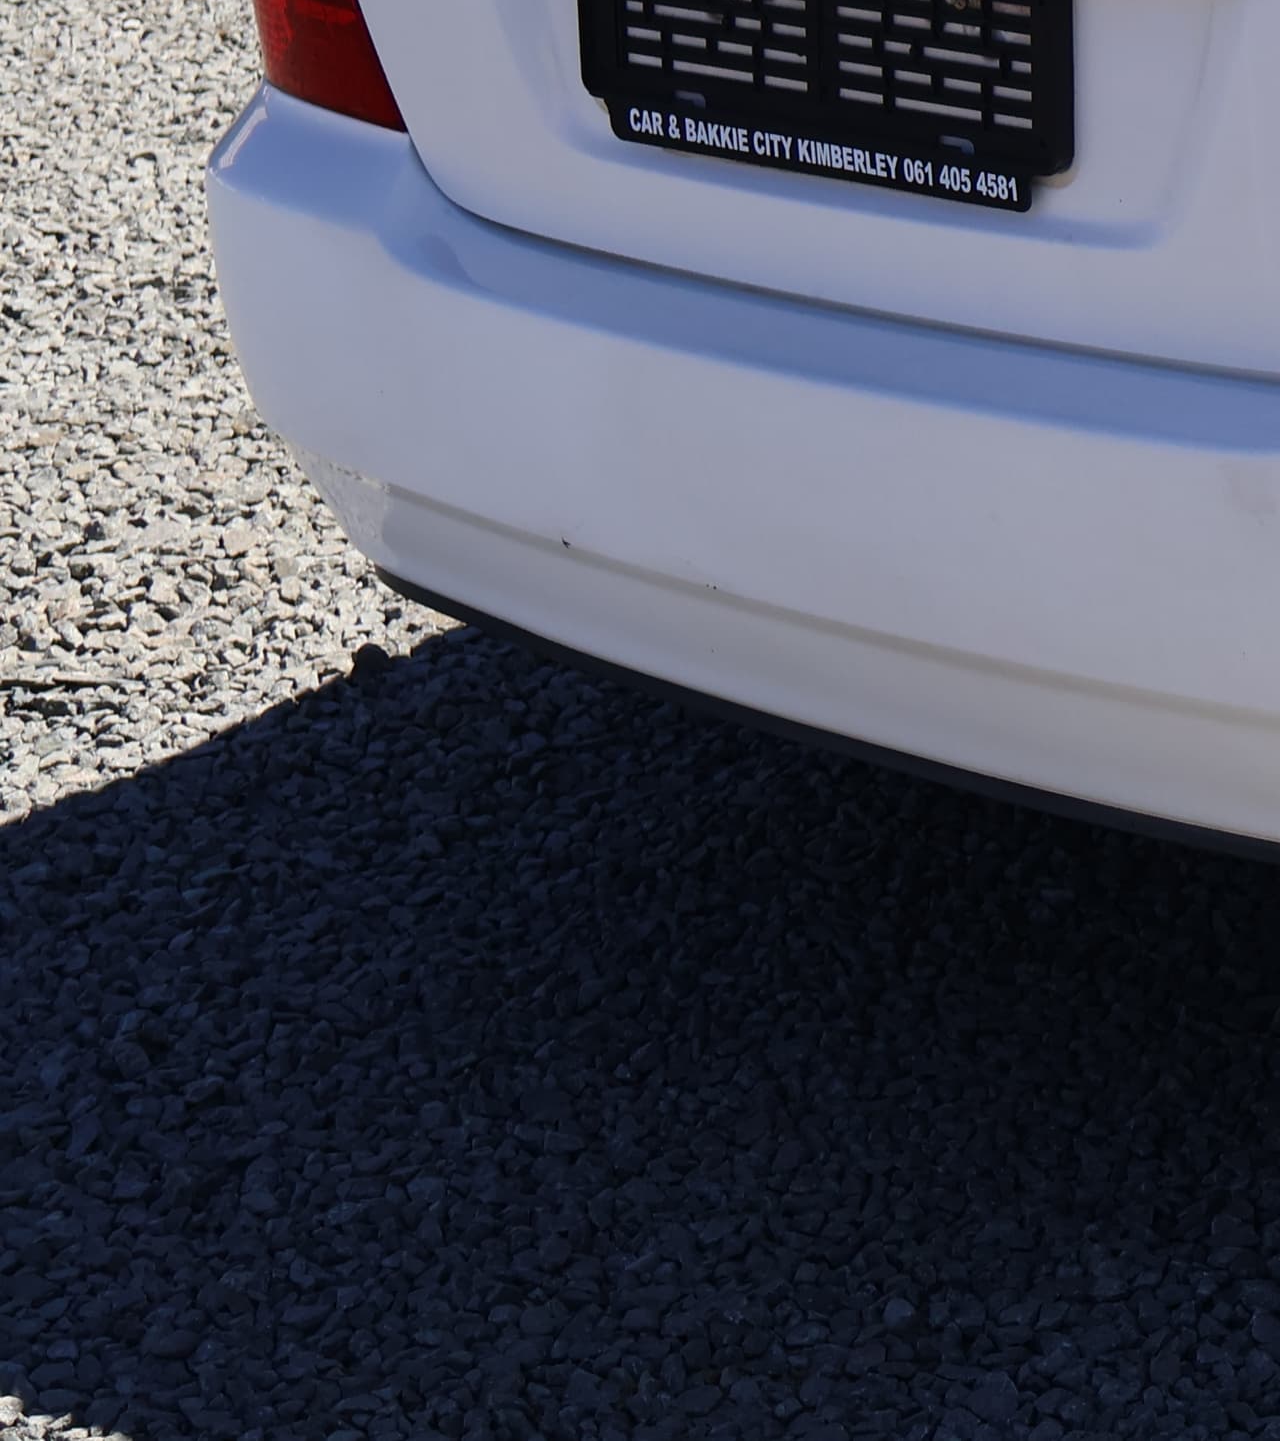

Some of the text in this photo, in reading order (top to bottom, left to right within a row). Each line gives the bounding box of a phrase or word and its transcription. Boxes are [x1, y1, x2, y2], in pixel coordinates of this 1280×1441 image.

[628, 107, 1019, 202] CAR & BAKKIE CITY KIMBERLEY 061 405 4581
